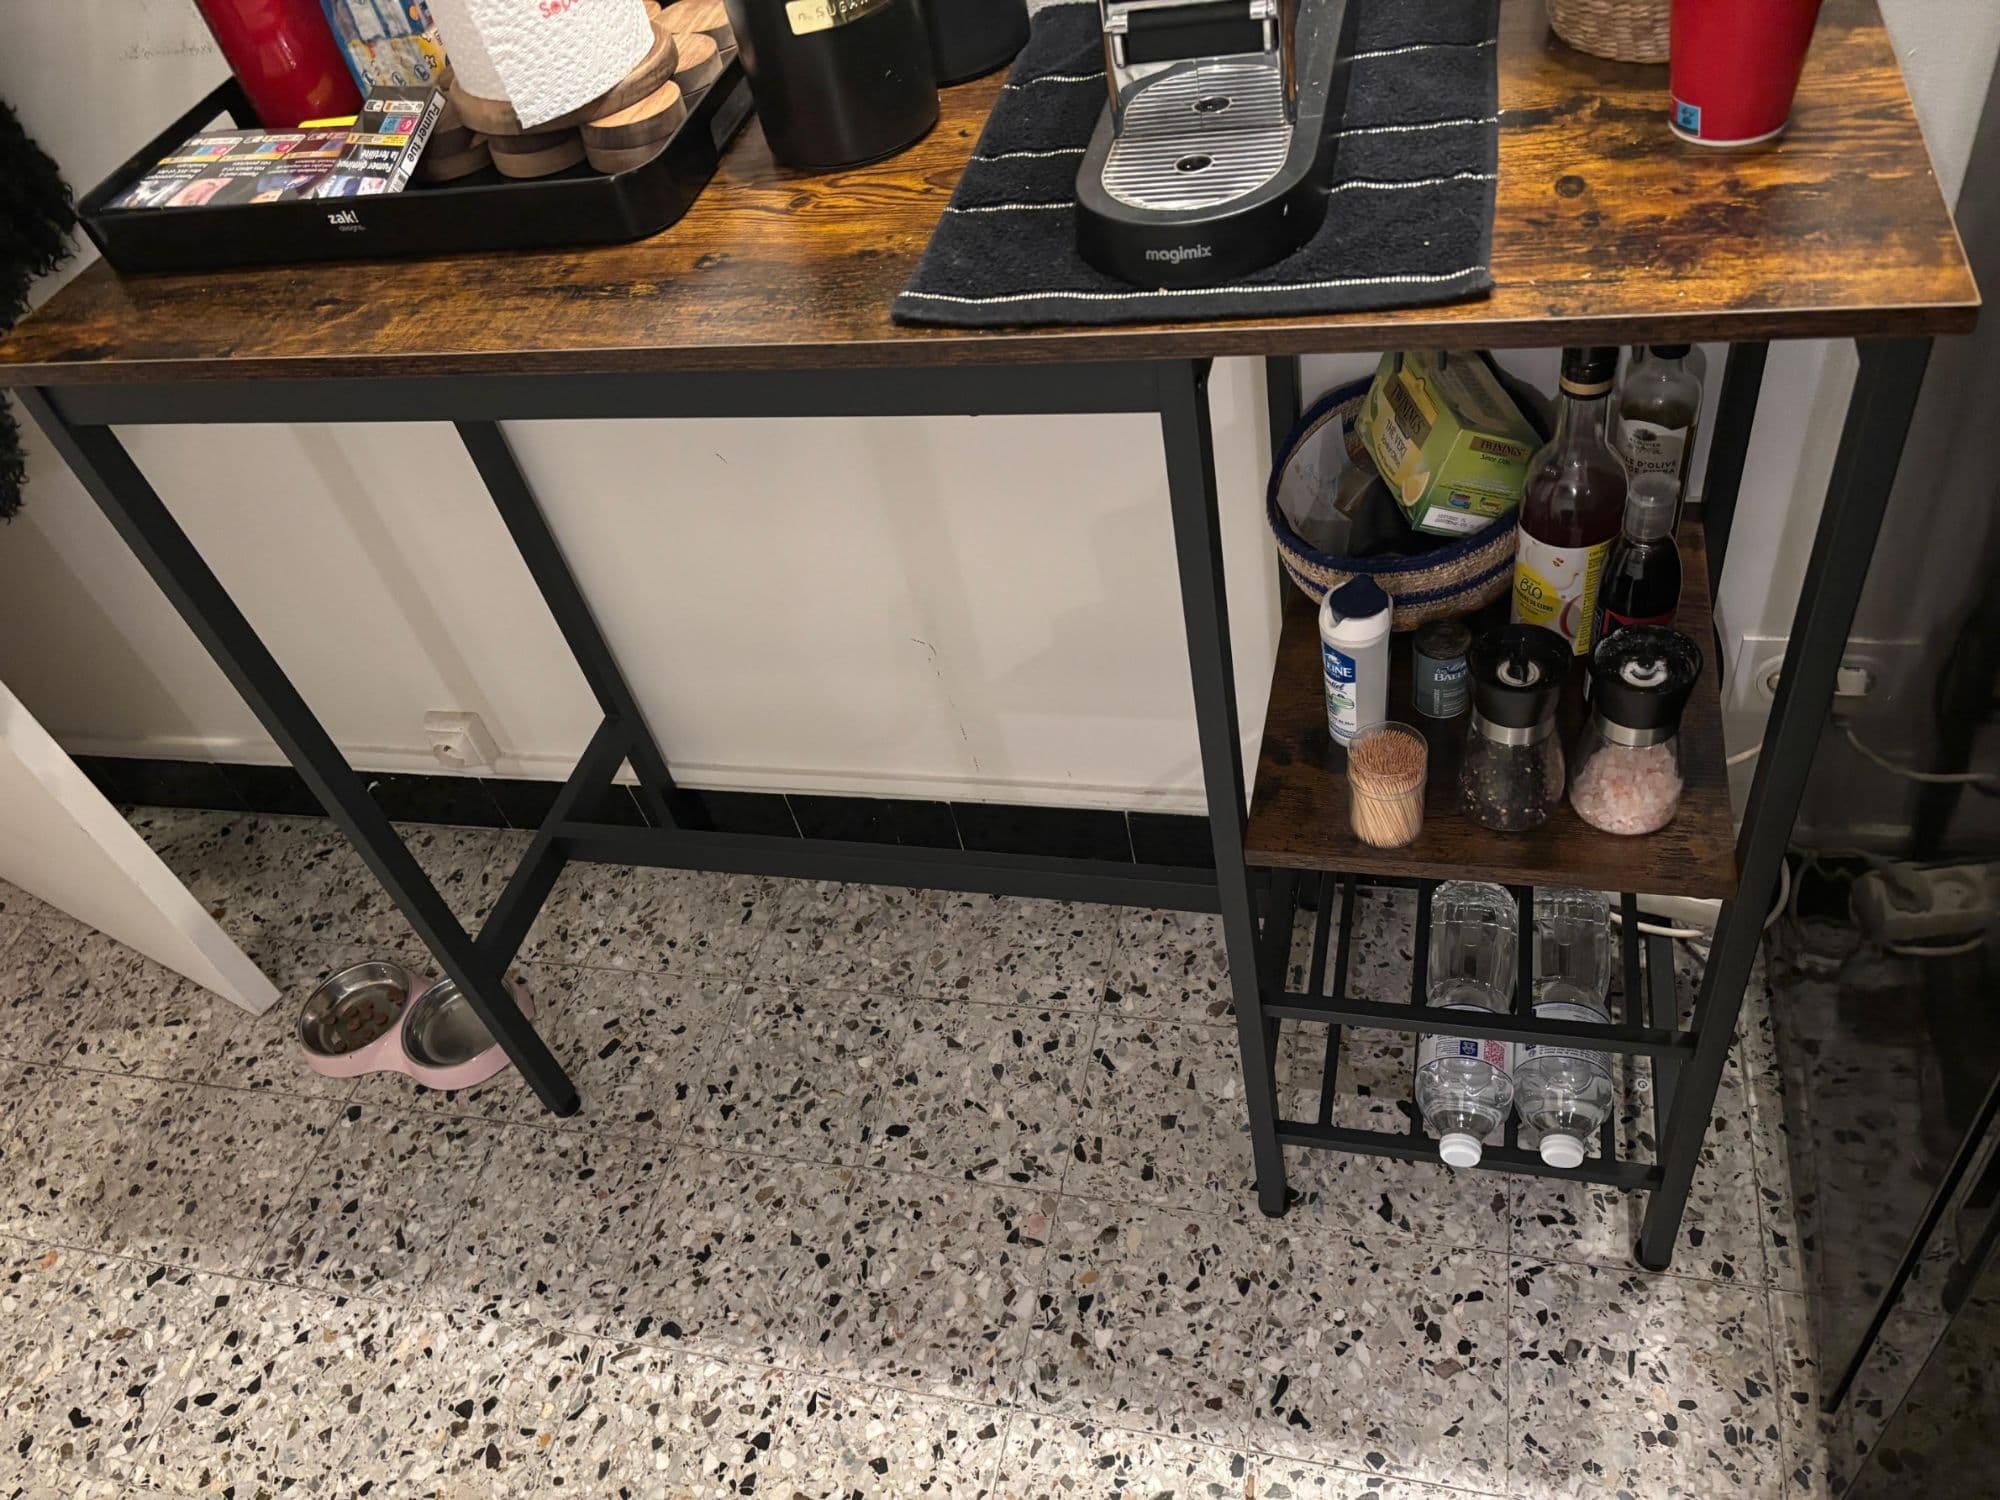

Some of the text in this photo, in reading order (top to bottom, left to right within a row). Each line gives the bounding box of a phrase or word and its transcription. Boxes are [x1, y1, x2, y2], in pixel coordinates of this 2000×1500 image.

[406, 103, 440, 163] Fumer tue
[327, 210, 359, 224] zak!
[1145, 244, 1212, 264] magimix
[1480, 440, 1522, 457] TWININGS
